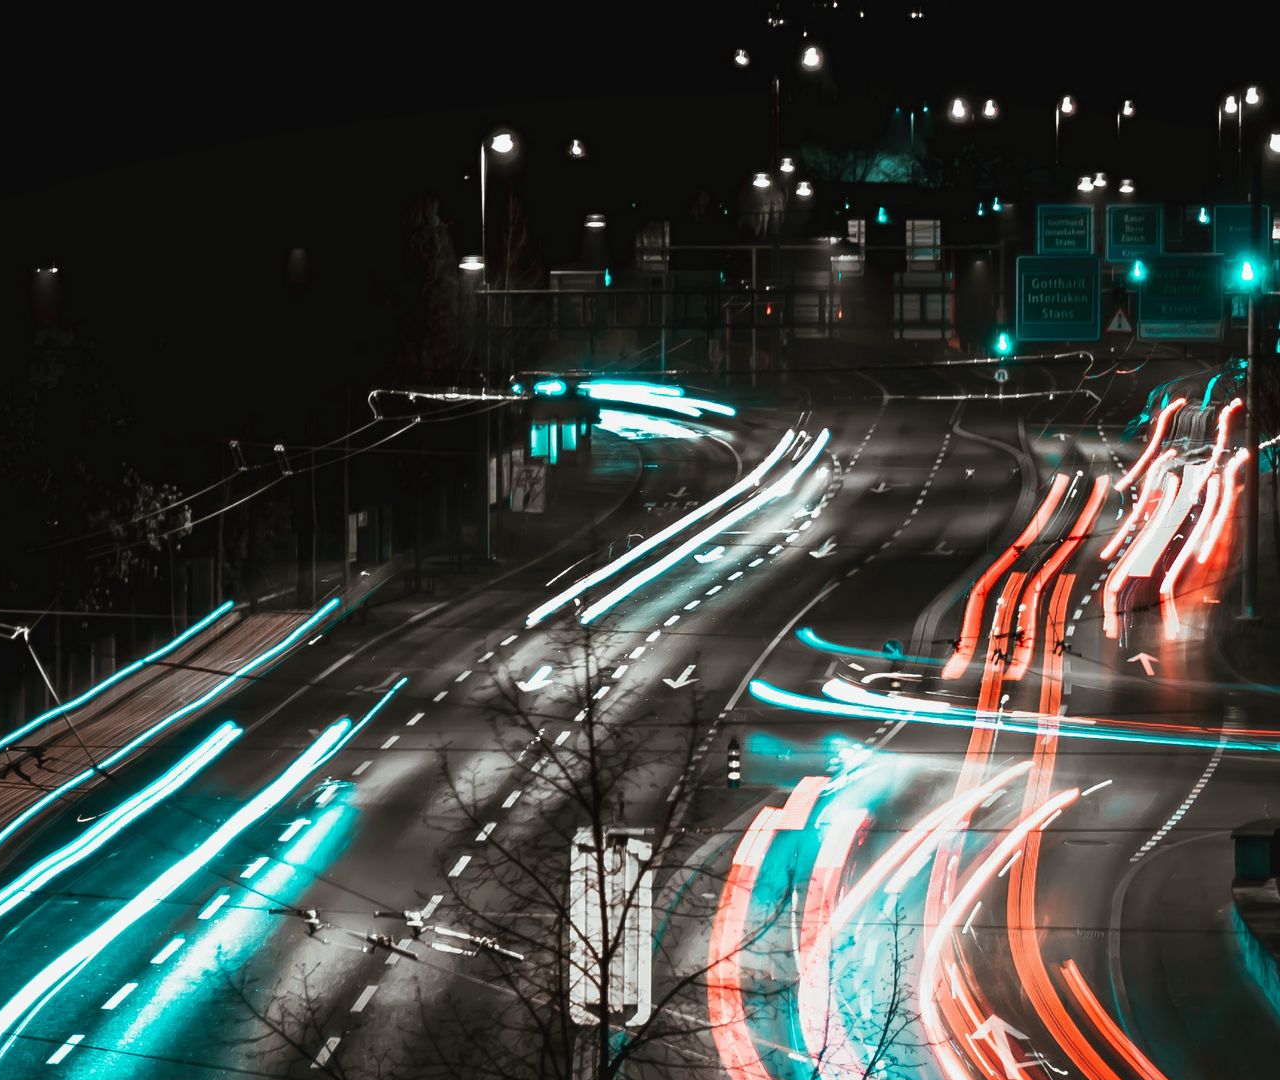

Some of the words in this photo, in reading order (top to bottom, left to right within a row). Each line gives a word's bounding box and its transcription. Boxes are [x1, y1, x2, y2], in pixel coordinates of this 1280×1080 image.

[1031, 278, 1086, 290] Gotthard
[1028, 292, 1088, 304] Interlaken
[1042, 308, 1075, 320] Stans
